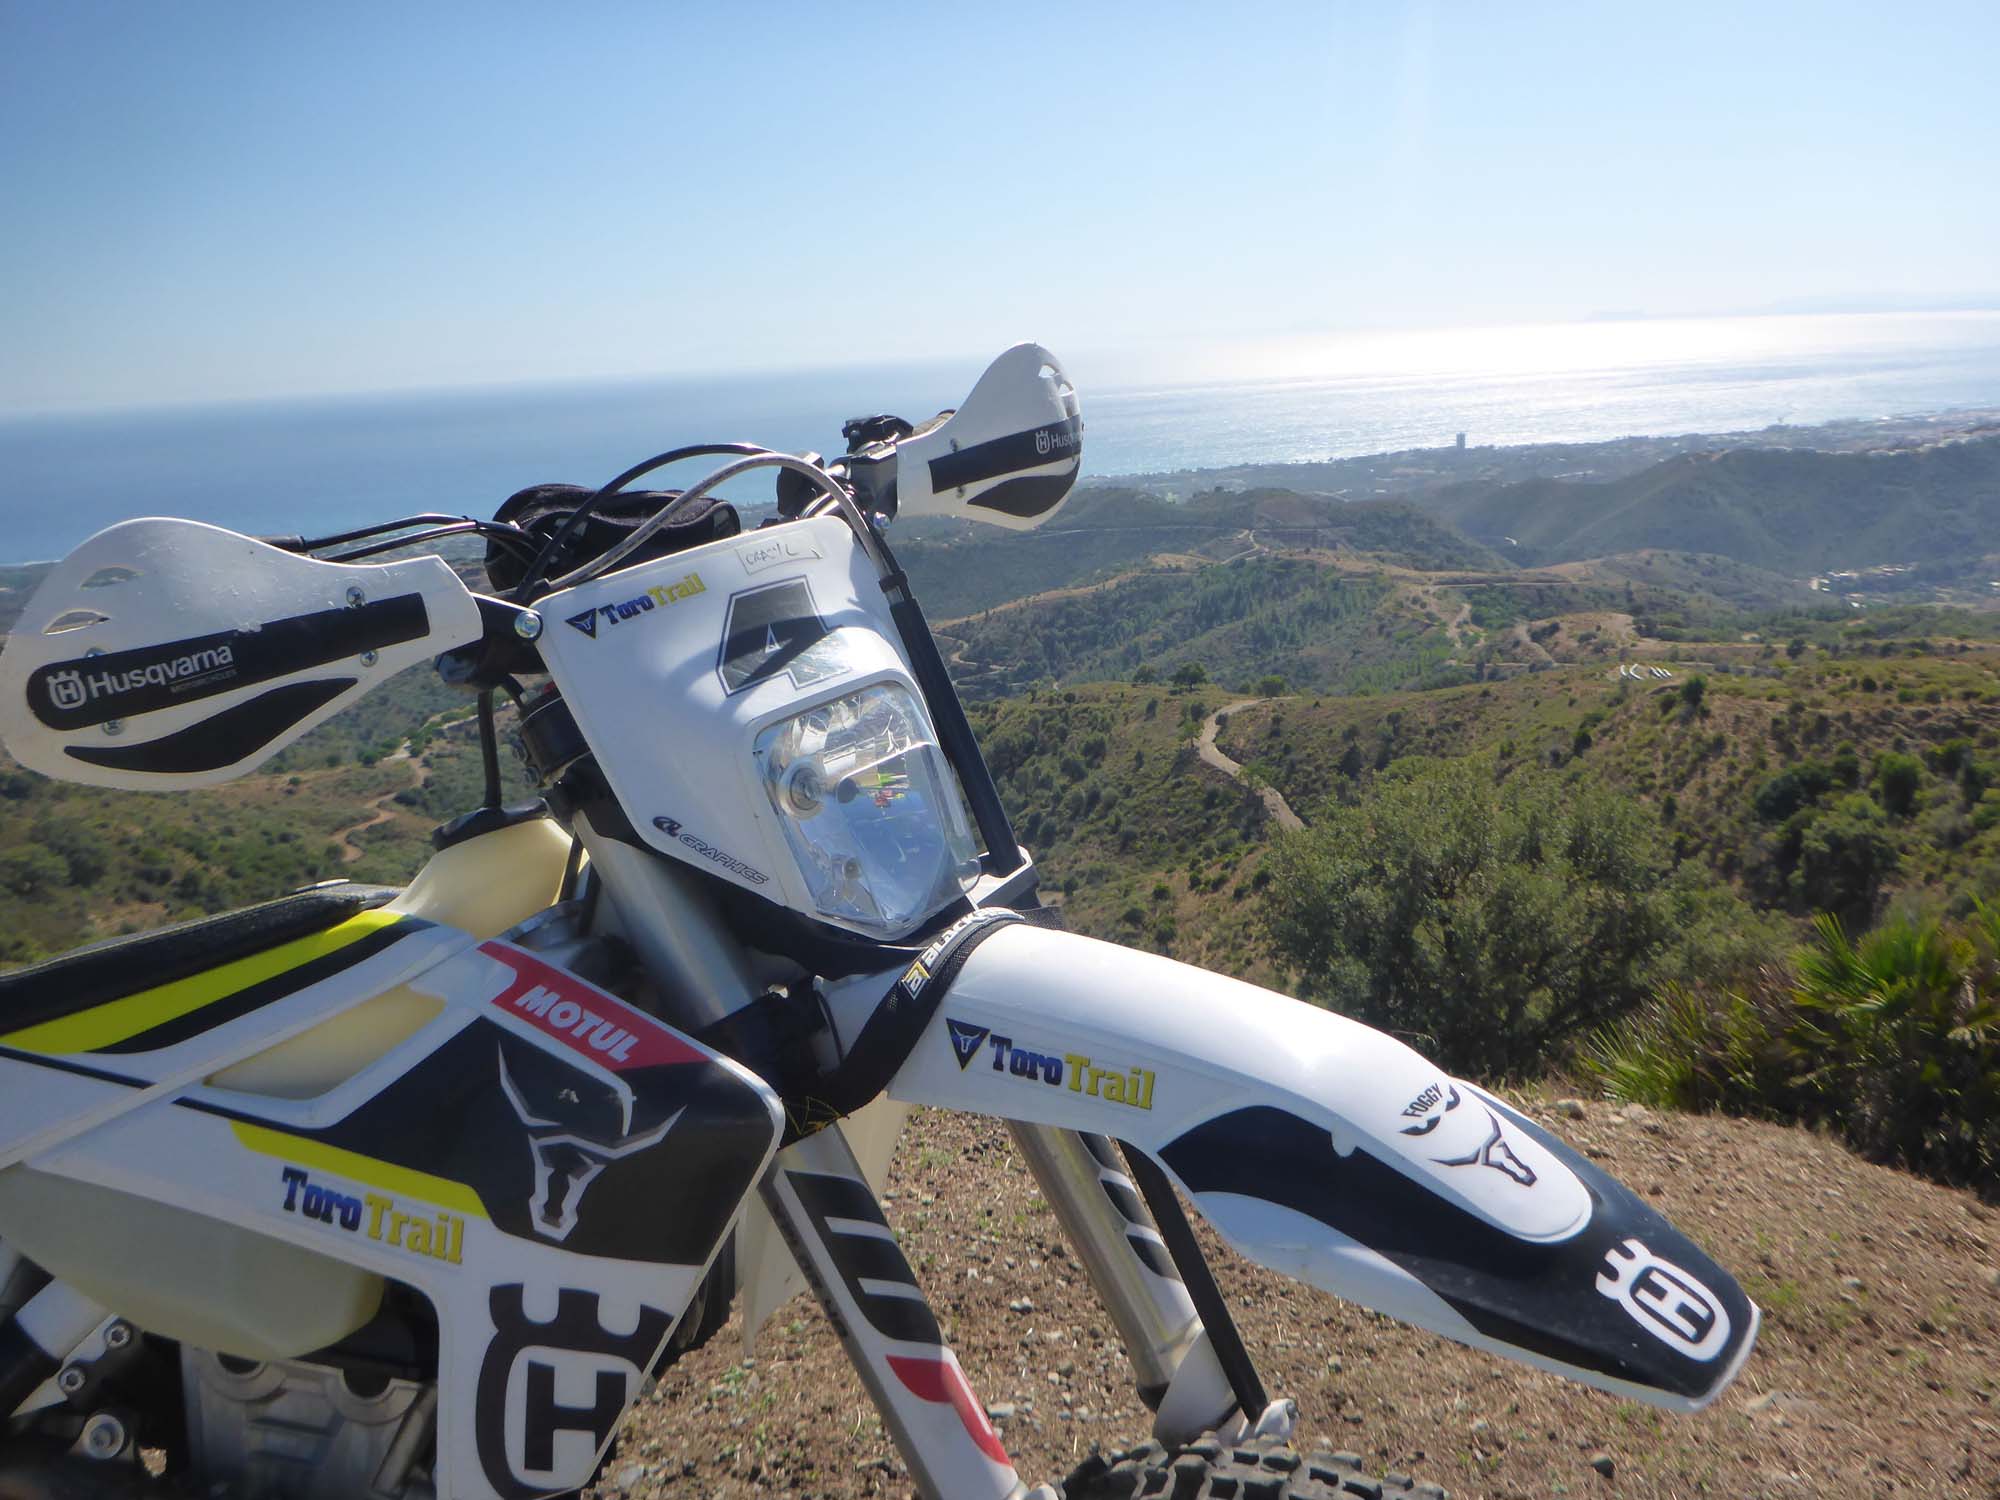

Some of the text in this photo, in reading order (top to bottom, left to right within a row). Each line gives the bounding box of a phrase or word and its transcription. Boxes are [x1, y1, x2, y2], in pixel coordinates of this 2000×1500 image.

[88, 645, 234, 700] Husqvarna
[679, 833, 769, 885] GRAPHICS
[514, 984, 640, 1063] MOTUL
[1400, 1082, 1443, 1118] FOGGY
